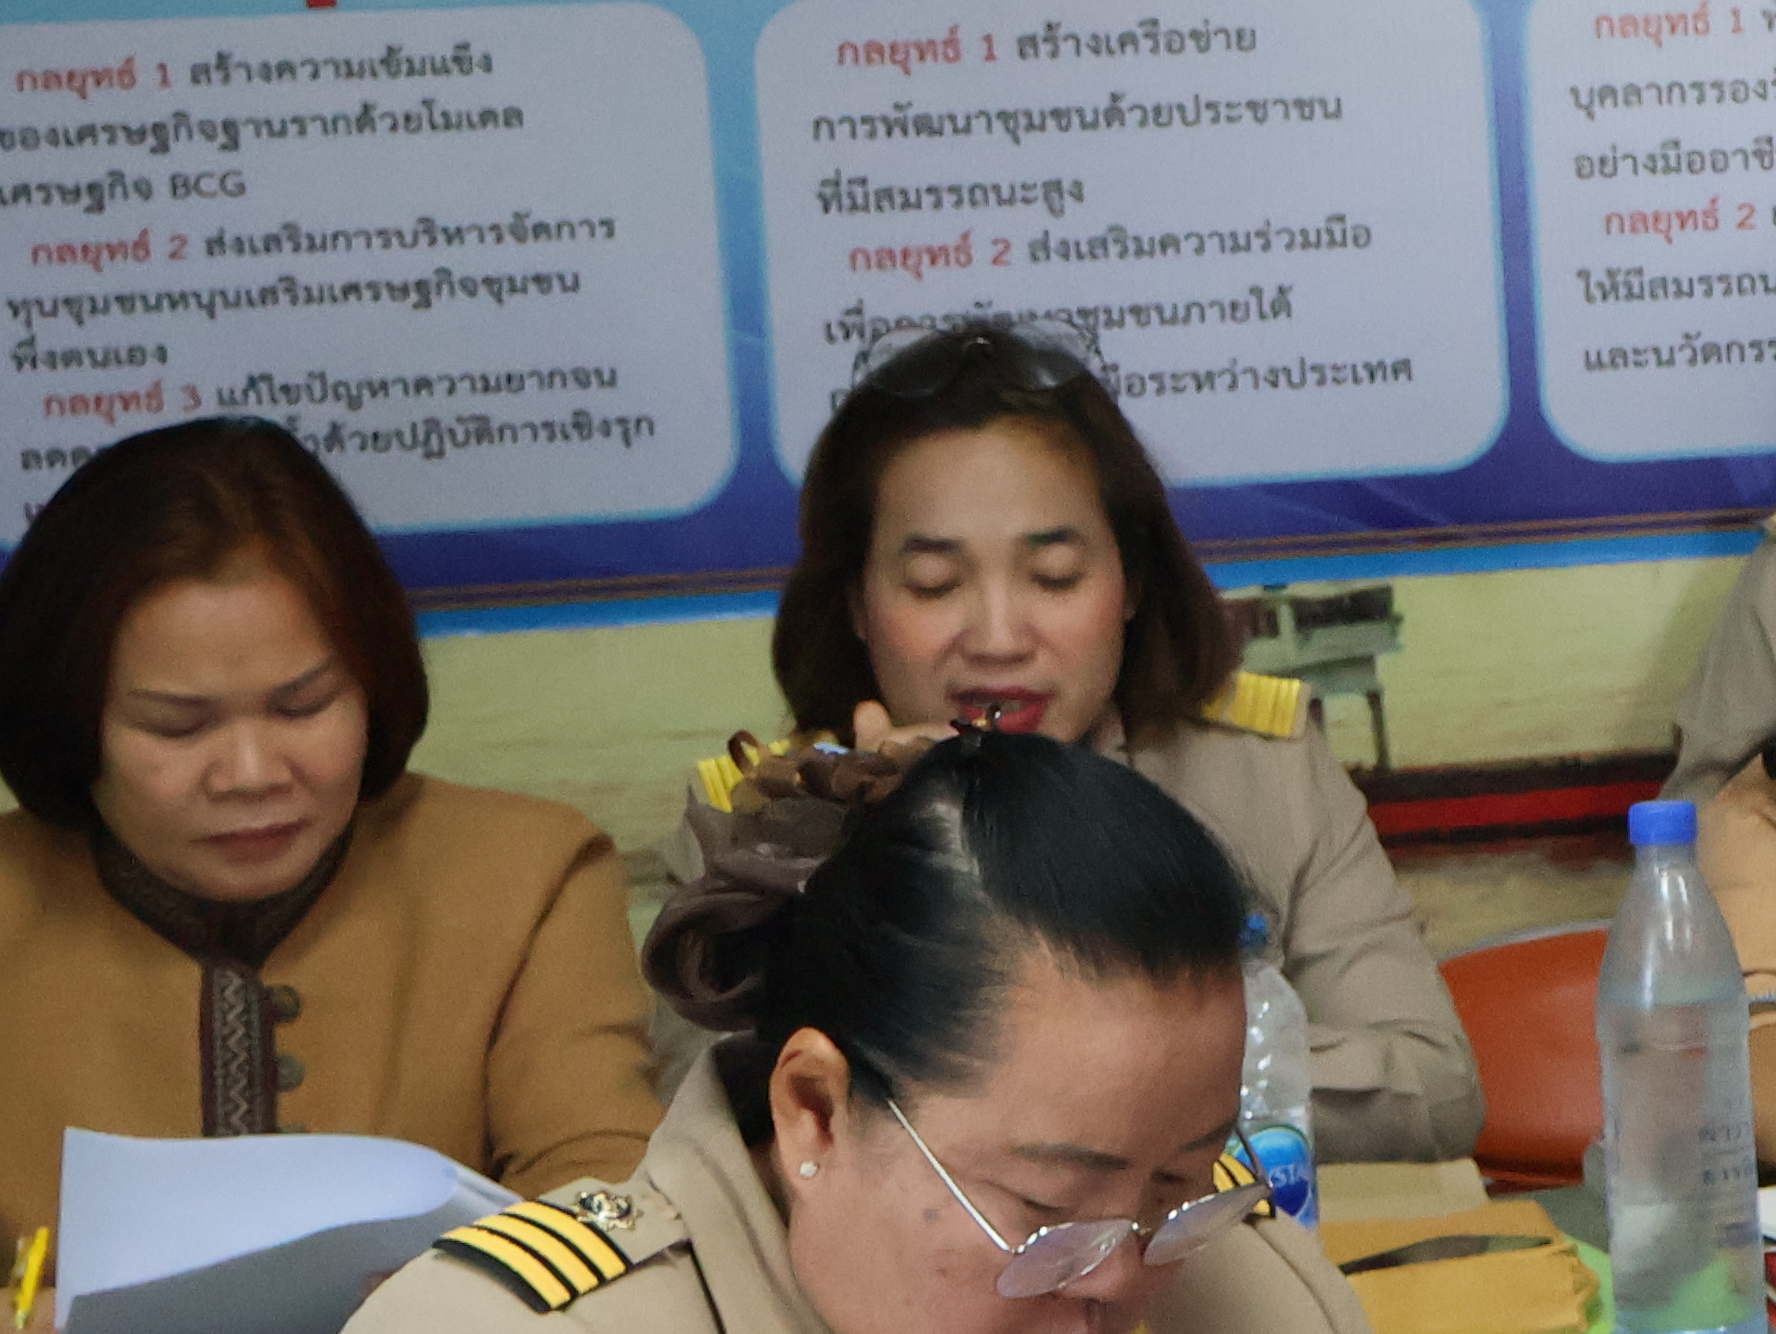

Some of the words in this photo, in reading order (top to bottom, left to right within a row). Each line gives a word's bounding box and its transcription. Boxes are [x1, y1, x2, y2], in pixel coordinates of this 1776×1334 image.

[836, 25, 963, 76] กลยุทธ์
[982, 33, 999, 63] 1
[1016, 19, 1257, 63] สร้างเครือข่าย
[1594, 1, 1711, 47] กลยุทธ์
[1729, 9, 1743, 34] 1
[16, 56, 137, 101] กลยุทธ์
[157, 62, 172, 88] 1
[189, 41, 493, 87] สร้างความเข้มแข็ง
[811, 91, 1343, 146] การพัฒนาชุมชนด้วยประชาชน
[169, 169, 247, 200] BCG
[816, 167, 1085, 218] ที่มีสมรรถนะสูง
[31, 228, 152, 274] กลยุทธ์
[168, 233, 190, 262] 2
[204, 212, 616, 259] ส่งเสริมการบริหารจัดการ
[1604, 197, 1720, 244] กลยุทธ์
[1735, 203, 1757, 230] 2
[848, 230, 972, 280] กลยุทธ์
[990, 238, 1014, 267] 2
[1027, 221, 1373, 265] ส่งเสริมความร่วมมือ
[43, 381, 165, 424] กลยุทธ์
[182, 386, 203, 414] 3
[216, 364, 618, 414] แก้ไขปัญหาความยากจน
